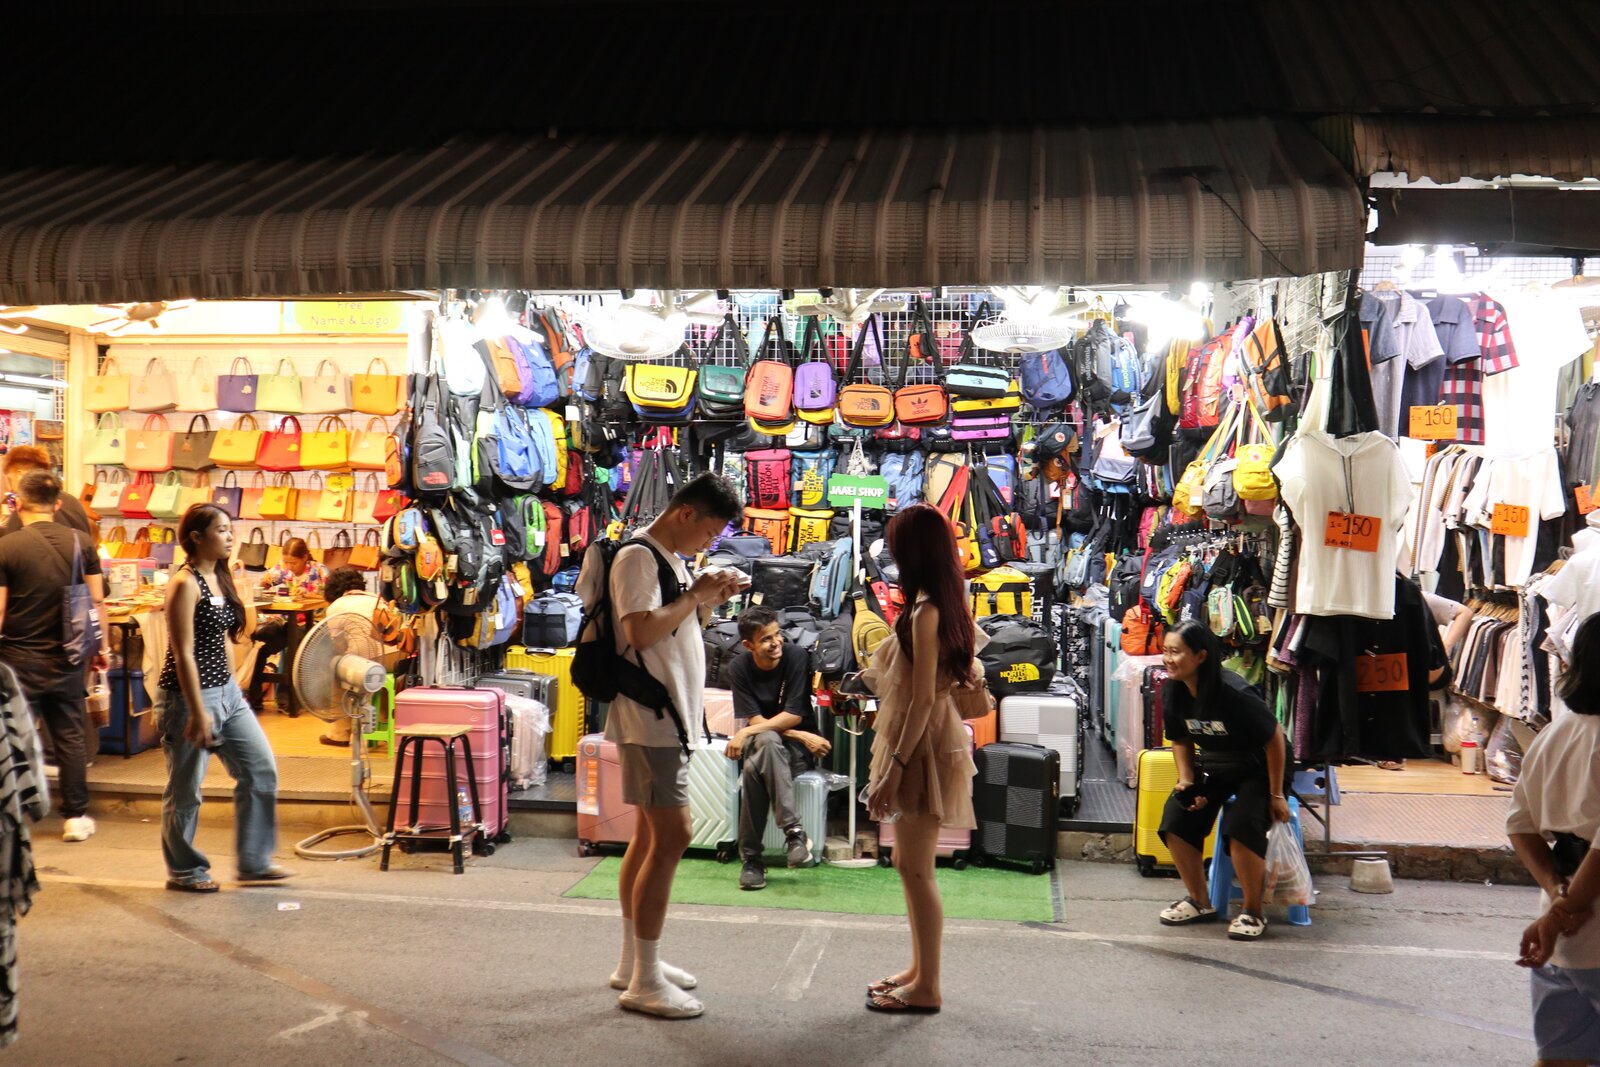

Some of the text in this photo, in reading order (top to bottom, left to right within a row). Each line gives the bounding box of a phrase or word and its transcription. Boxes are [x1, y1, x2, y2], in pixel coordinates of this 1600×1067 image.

[337, 302, 364, 310] Free
[311, 315, 390, 328] Name & Logo
[1424, 407, 1452, 426] 150
[759, 472, 767, 494] FACE
[765, 464, 774, 494] NORTH
[815, 475, 824, 492] THE
[857, 487, 884, 497] SHOP
[1503, 507, 1528, 523] 150
[1342, 516, 1372, 537] 150
[1034, 596, 1044, 622] THE
[999, 670, 1025, 678] NORTH
[1008, 676, 1027, 684] FACE
[1357, 658, 1403, 686] 250
